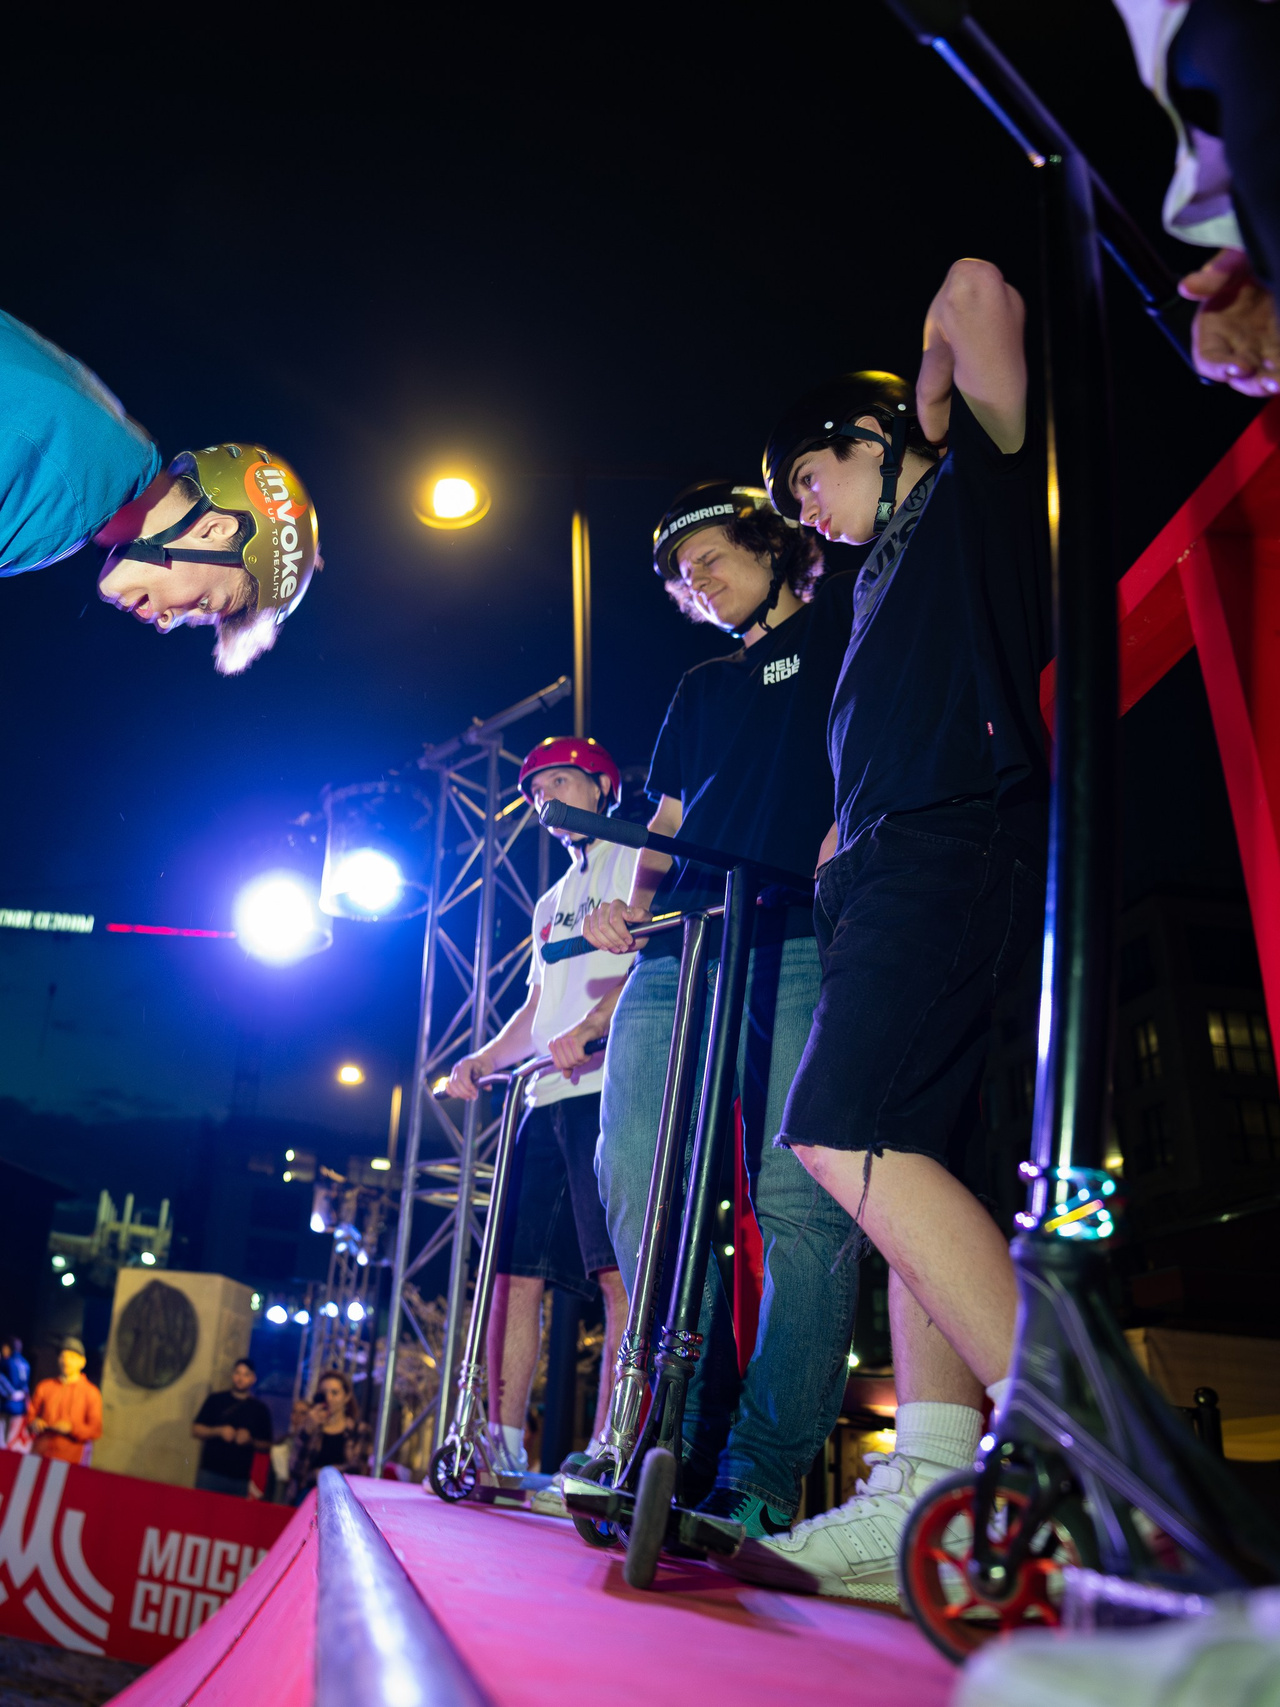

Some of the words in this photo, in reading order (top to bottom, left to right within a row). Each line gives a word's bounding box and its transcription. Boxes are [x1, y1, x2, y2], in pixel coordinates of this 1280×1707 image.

[254, 470, 272, 504] WAKE
[267, 507, 276, 525] UP
[262, 468, 303, 600] invoke
[271, 528, 279, 545] TO
[271, 550, 280, 600] REALITY
[763, 653, 800, 675] HELL
[763, 662, 800, 686] RIDE
[129, 1579, 230, 1640] СПО
